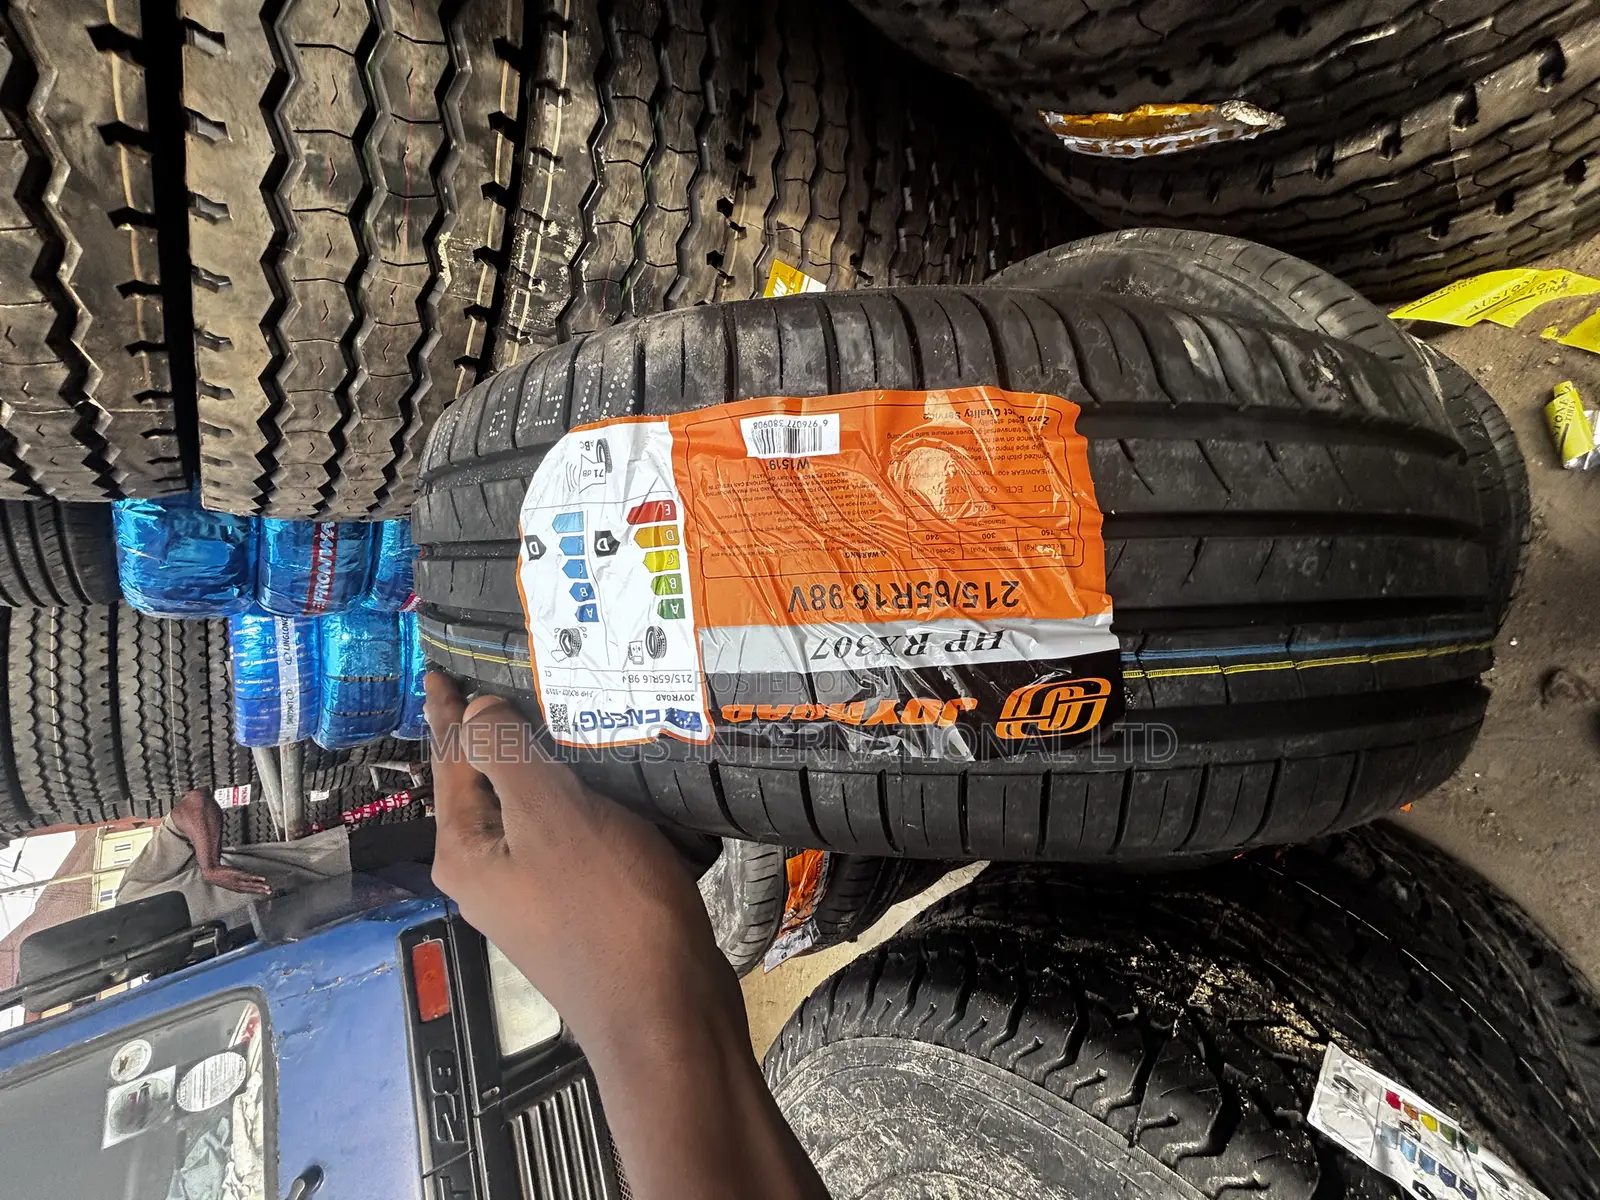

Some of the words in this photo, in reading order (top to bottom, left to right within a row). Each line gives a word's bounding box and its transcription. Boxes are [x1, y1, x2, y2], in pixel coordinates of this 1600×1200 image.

[964, 407, 1001, 420] Quality
[752, 419, 784, 430] 380908
[787, 419, 819, 428] 976077
[593, 468, 605, 479] 71
[1032, 484, 1052, 493] DOT
[664, 504, 672, 516] E
[665, 528, 675, 541] D
[926, 533, 940, 541] 240
[982, 532, 996, 540] 300
[528, 541, 540, 556] D
[596, 536, 611, 552] D
[668, 577, 677, 589] B
[579, 586, 587, 597] B
[788, 581, 843, 613] 98V
[852, 578, 1021, 612] 215/65R16
[585, 607, 594, 619] A
[670, 603, 680, 614] A
[944, 628, 1005, 653] HP
[811, 633, 931, 661] RX307
[656, 693, 696, 702] JOYROAD
[721, 698, 979, 727] JOYROAD
